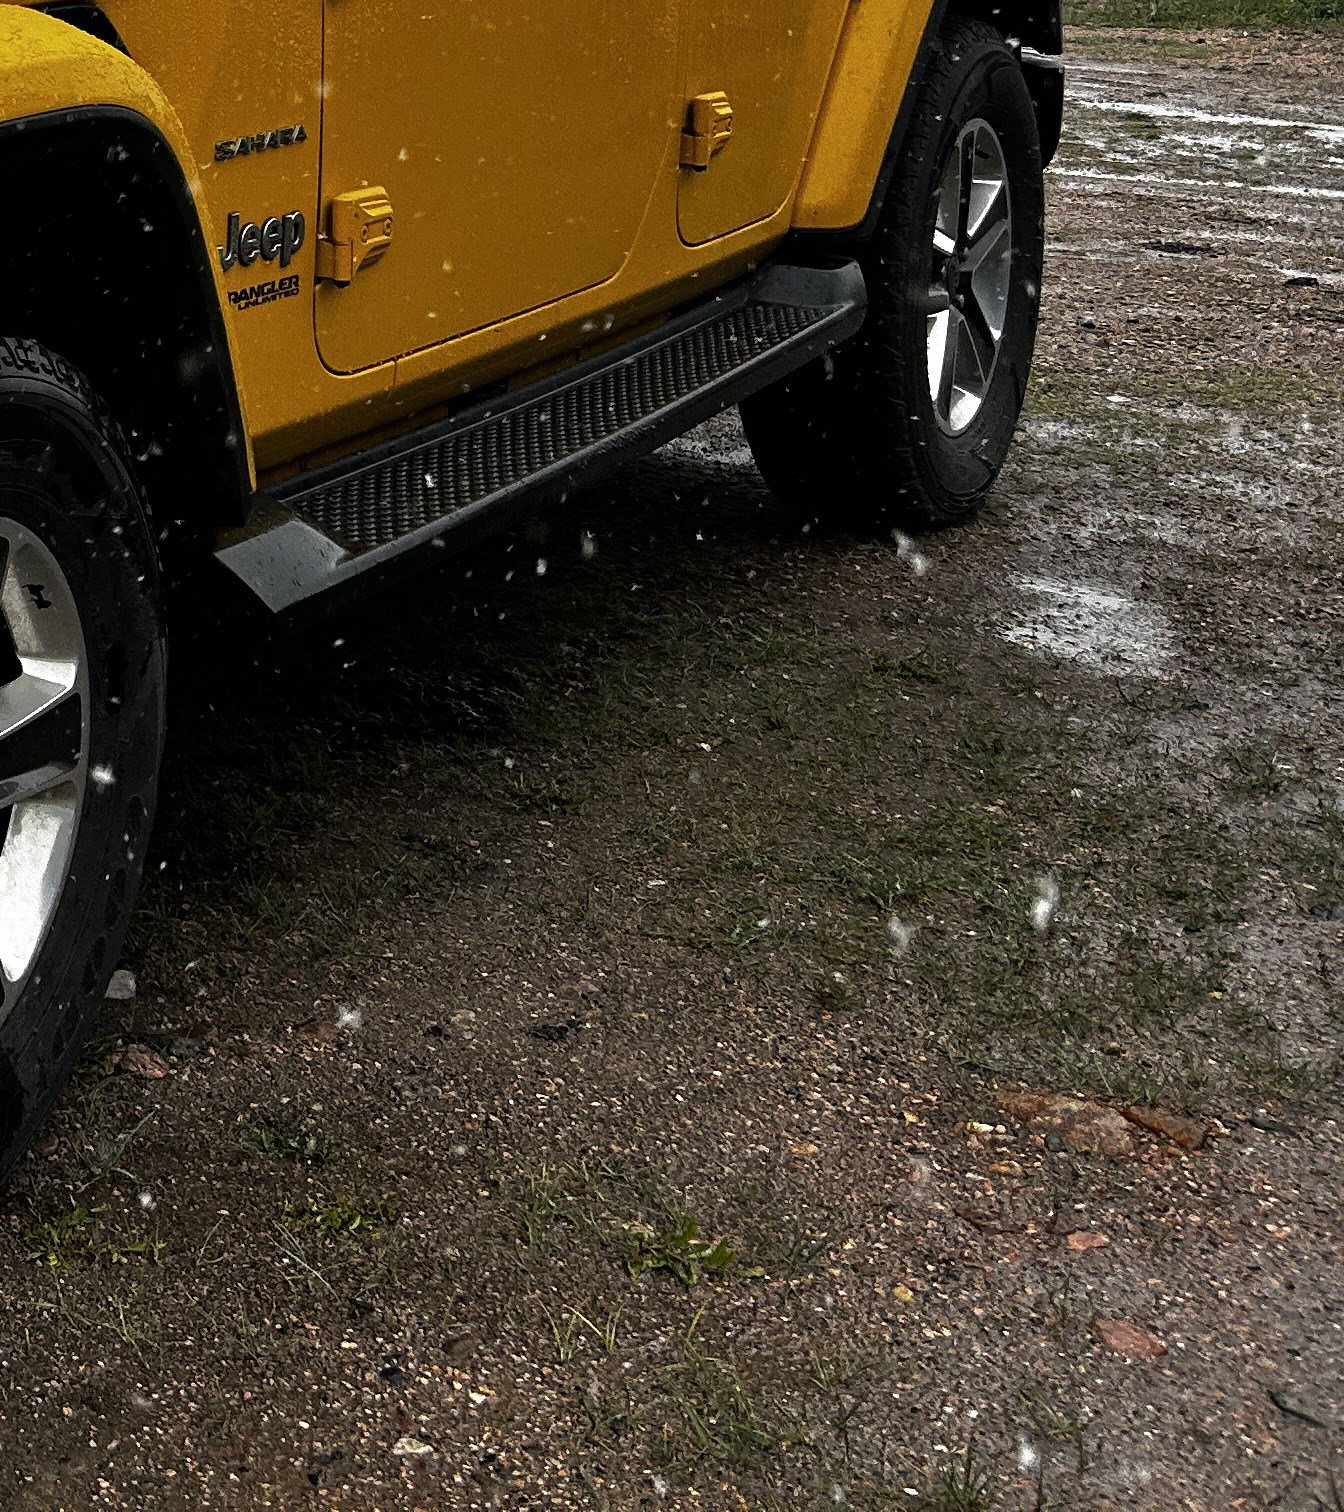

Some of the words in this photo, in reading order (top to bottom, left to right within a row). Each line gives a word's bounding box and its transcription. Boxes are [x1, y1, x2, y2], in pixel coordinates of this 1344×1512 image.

[214, 125, 307, 162] SAHARA
[216, 210, 306, 272] Jeep
[227, 274, 300, 305] RANGLER
